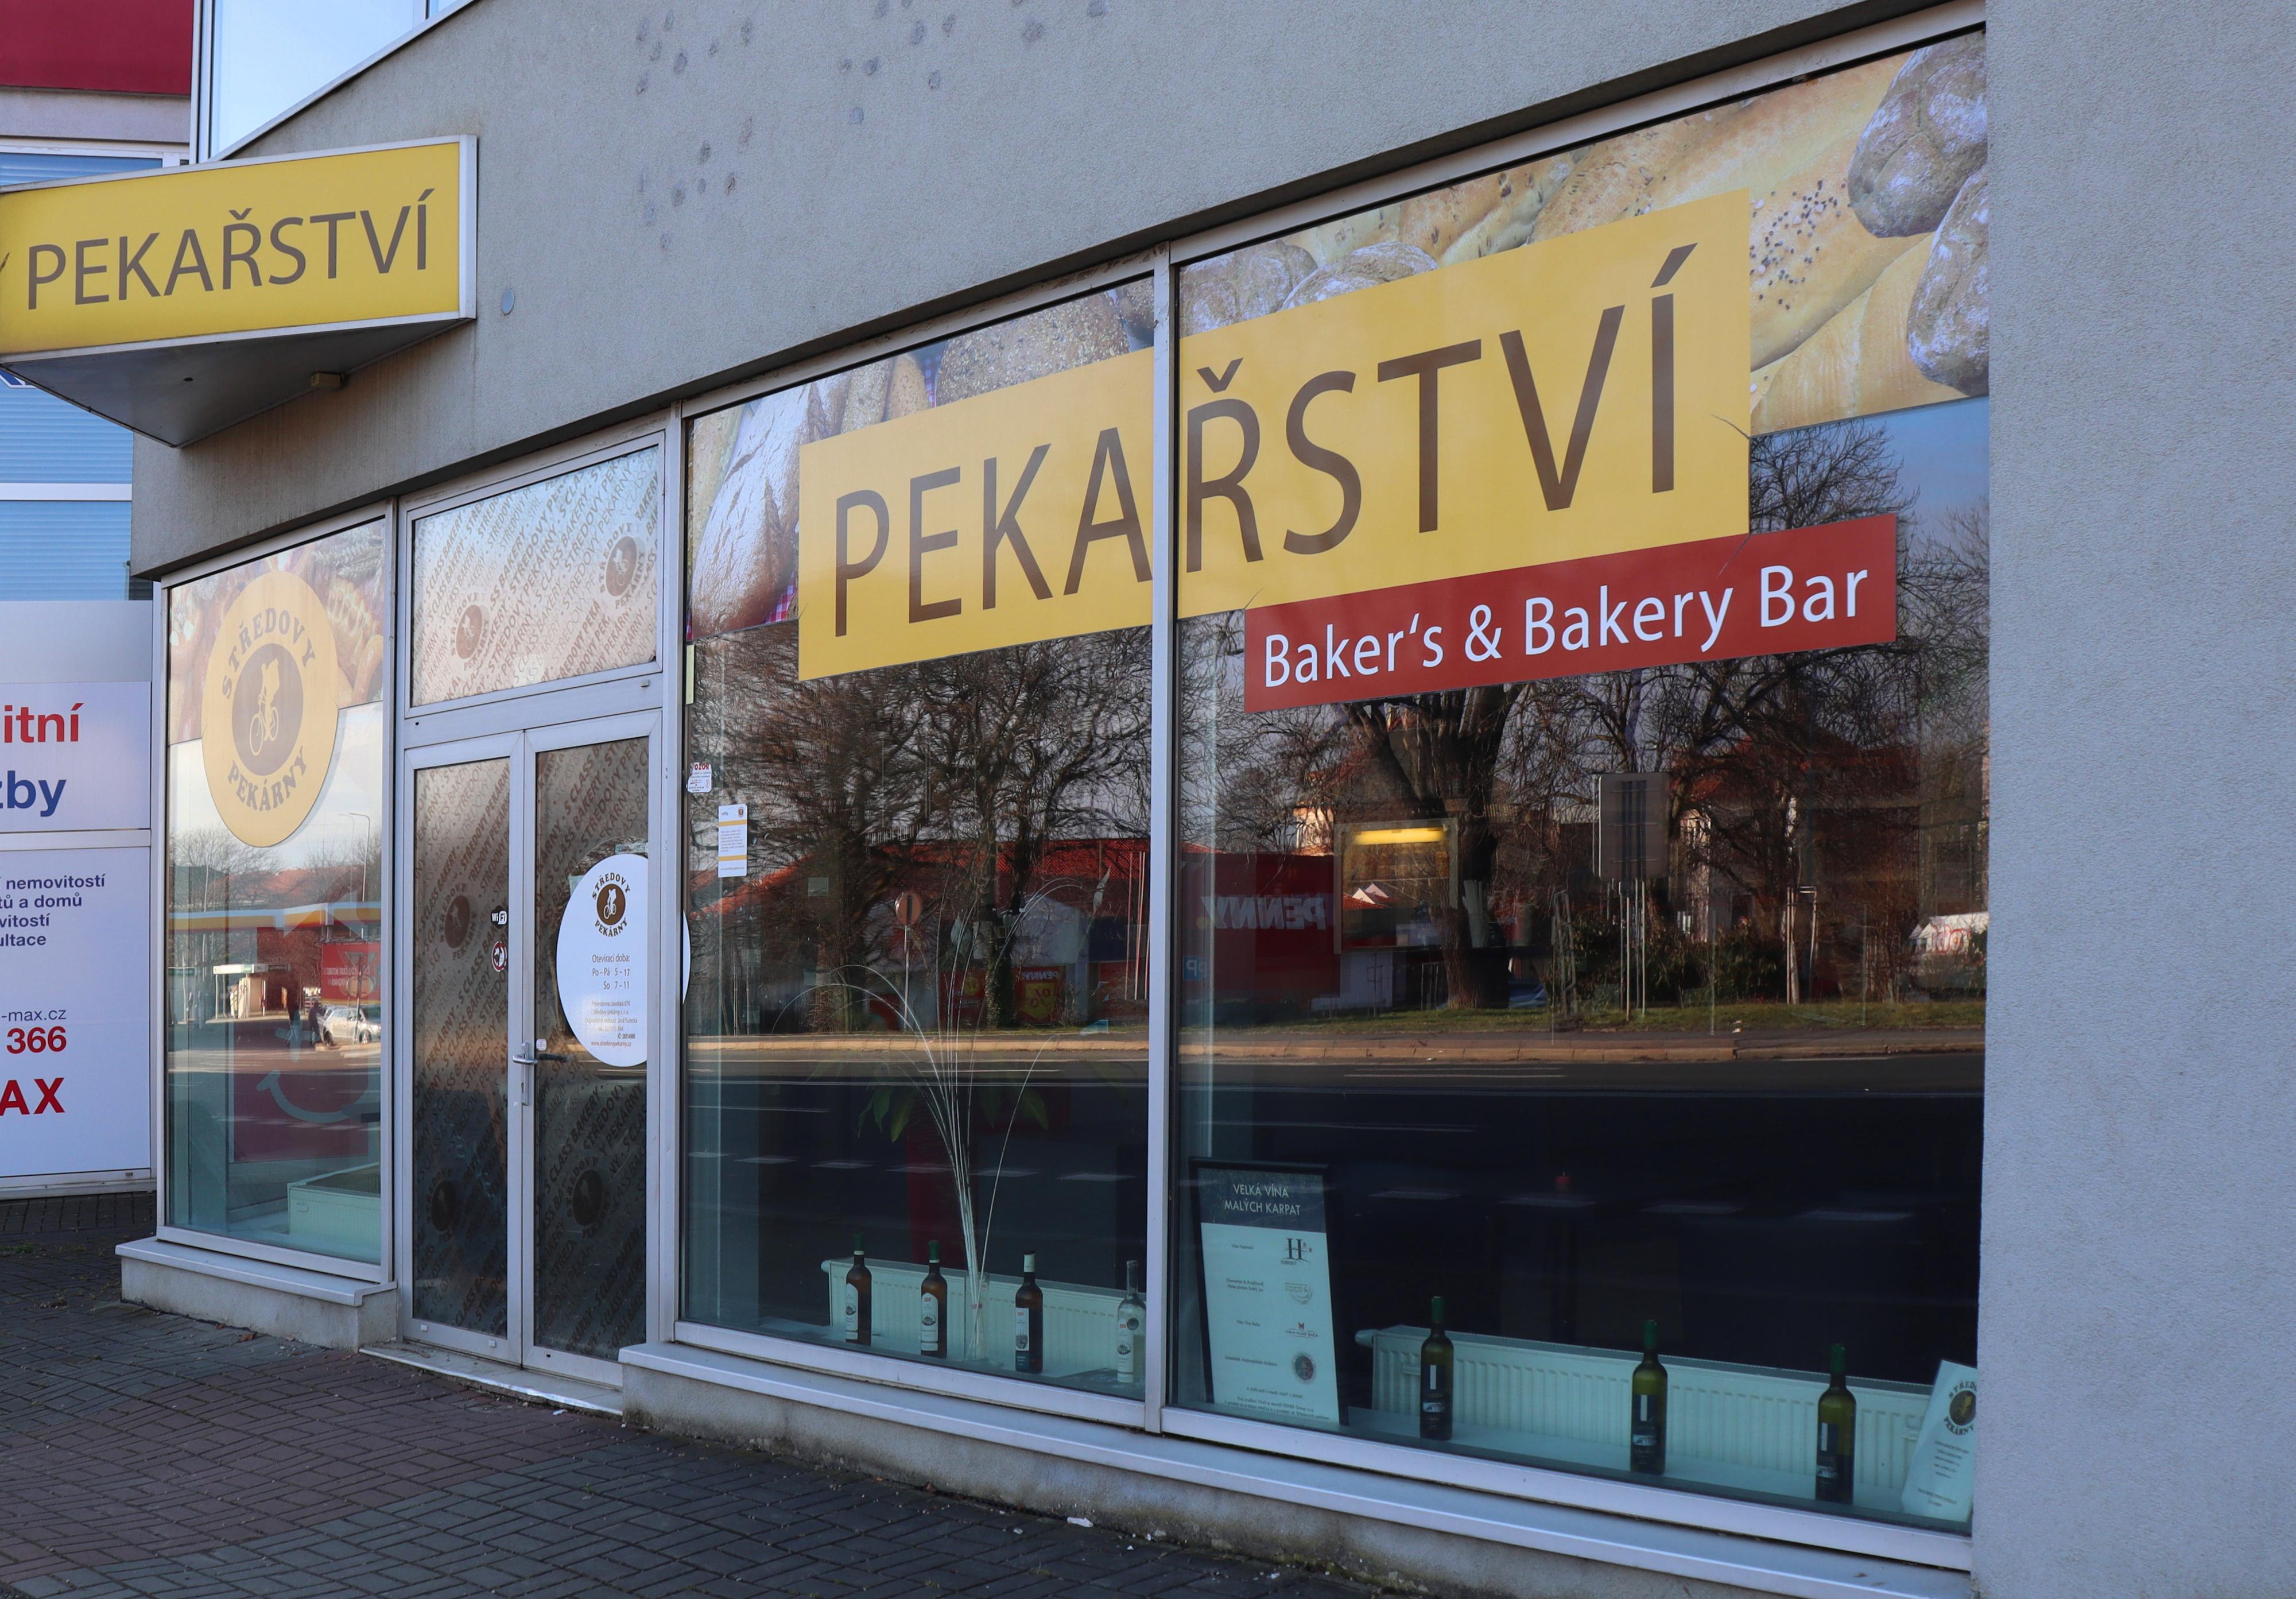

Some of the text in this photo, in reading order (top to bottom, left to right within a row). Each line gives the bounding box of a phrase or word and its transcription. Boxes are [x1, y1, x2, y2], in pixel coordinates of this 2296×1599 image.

[28, 188, 435, 310] PEKAŘSTVÍ
[833, 243, 1697, 637] PEKAŘSTVÍ
[443, 513, 463, 558] BAKERY
[499, 526, 526, 588] BAKERY
[541, 545, 563, 591] CLASS
[561, 487, 588, 548] BAKERY
[445, 539, 464, 584] BAKERY
[518, 629, 539, 673] CLASS
[537, 578, 563, 633] BAKERY
[1464, 604, 1503, 662] &
[1525, 584, 1734, 653] Bakery
[1760, 565, 1868, 628] Bar
[5, 703, 84, 742] itní
[0, 771, 67, 817] by
[227, 745, 307, 811] PEKÁRNY
[570, 754, 594, 803] CLASS
[552, 826, 575, 872] CLASS
[573, 769, 603, 831] BAKERY
[6, 874, 106, 889] nemovitostí
[437, 847, 457, 892] BAKERY
[592, 872, 630, 900] STŘEDOVY
[19, 898, 28, 908] a
[34, 892, 82, 908] domů
[595, 917, 629, 937] PEKÁRNY
[463, 949, 483, 994] CLASS
[592, 967, 630, 977] Po Pá 5 17
[615, 953, 630, 962] doba:
[603, 981, 629, 989] So 7 11
[448, 1015, 468, 1057] CLASS
[466, 965, 491, 1020] BAKERY
[6, 1026, 67, 1054] 366
[453, 1025, 478, 1077] BAKERY
[0, 1078, 65, 1116] AX
[550, 1137, 573, 1183] CLASS
[571, 1086, 600, 1143] BAKERY
[1224, 1198, 1301, 1216] MALÝCH KARPAT
[1233, 1183, 1289, 1198] VELKÁ VÍNA
